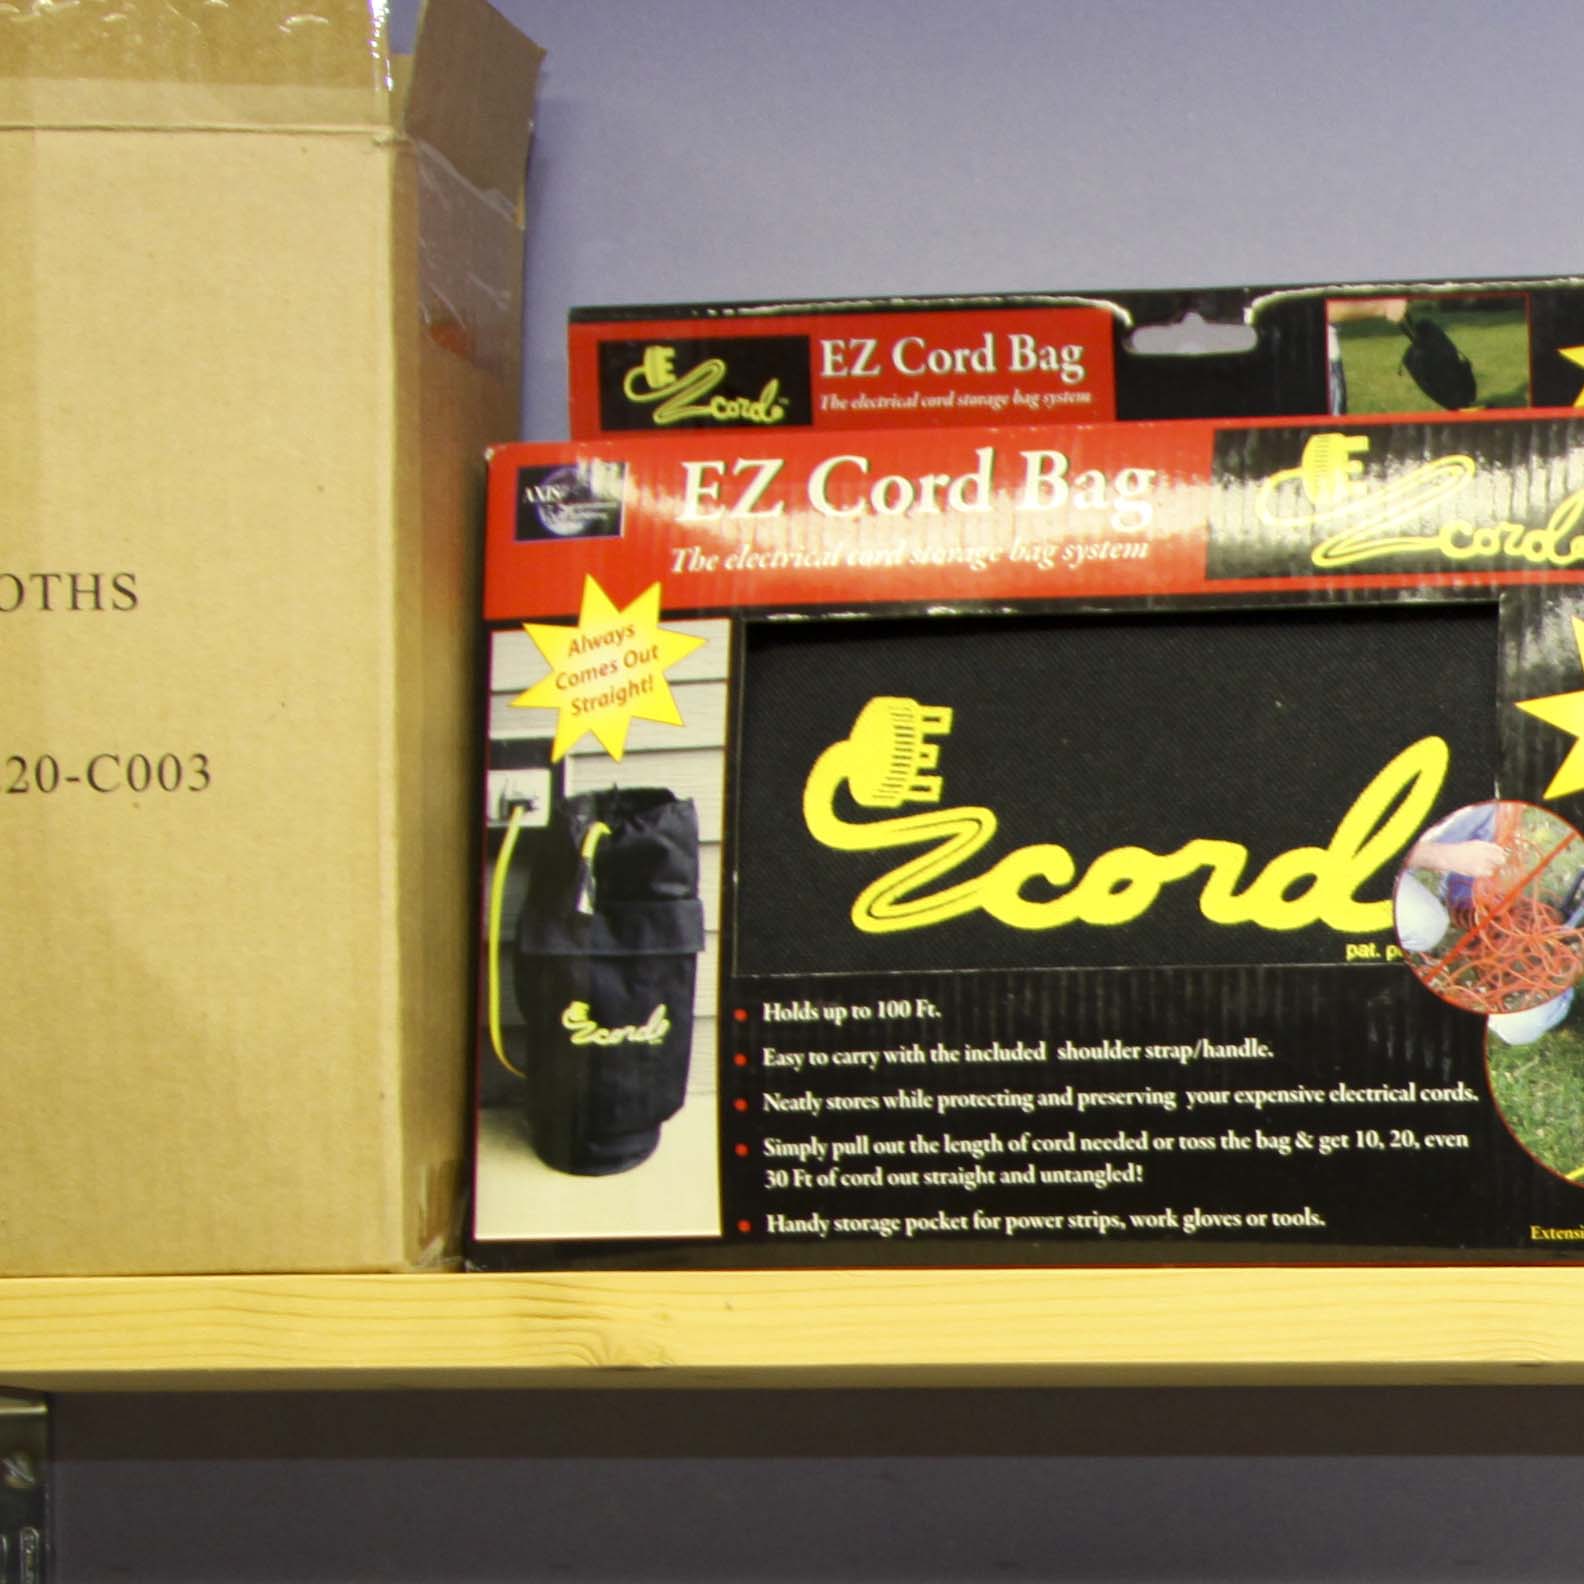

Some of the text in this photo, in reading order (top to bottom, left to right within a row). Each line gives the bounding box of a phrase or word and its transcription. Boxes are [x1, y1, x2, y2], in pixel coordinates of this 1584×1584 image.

[820, 332, 1085, 383] EZ Cord Bag
[676, 457, 784, 522] EZ
[807, 446, 997, 520] Cord
[1018, 449, 1158, 530] Bag
[671, 538, 1150, 574] The electrical cord storage bag system
[0, 572, 139, 612] OTHS
[568, 624, 635, 658] Always
[555, 644, 658, 690] Comes Out
[571, 674, 654, 716] Straight!
[6, 753, 211, 794] 20-C003
[763, 999, 941, 1026] Holds up to 100 Ft.
[763, 1038, 1274, 1072] Easy to carry with the included shoulder strap/handle.
[763, 1081, 1479, 1116] Neatly stores while protecting and preserving your expensive electrical cords.
[764, 1129, 1469, 1162] Simply pull out the length of cord needed or toss the bag & get 10, 20, even
[765, 1162, 1143, 1190] 30 Ft of cord out straight and untangled!
[767, 1206, 1326, 1237] Handy storage pocket for power strips, work gloves or tools.
